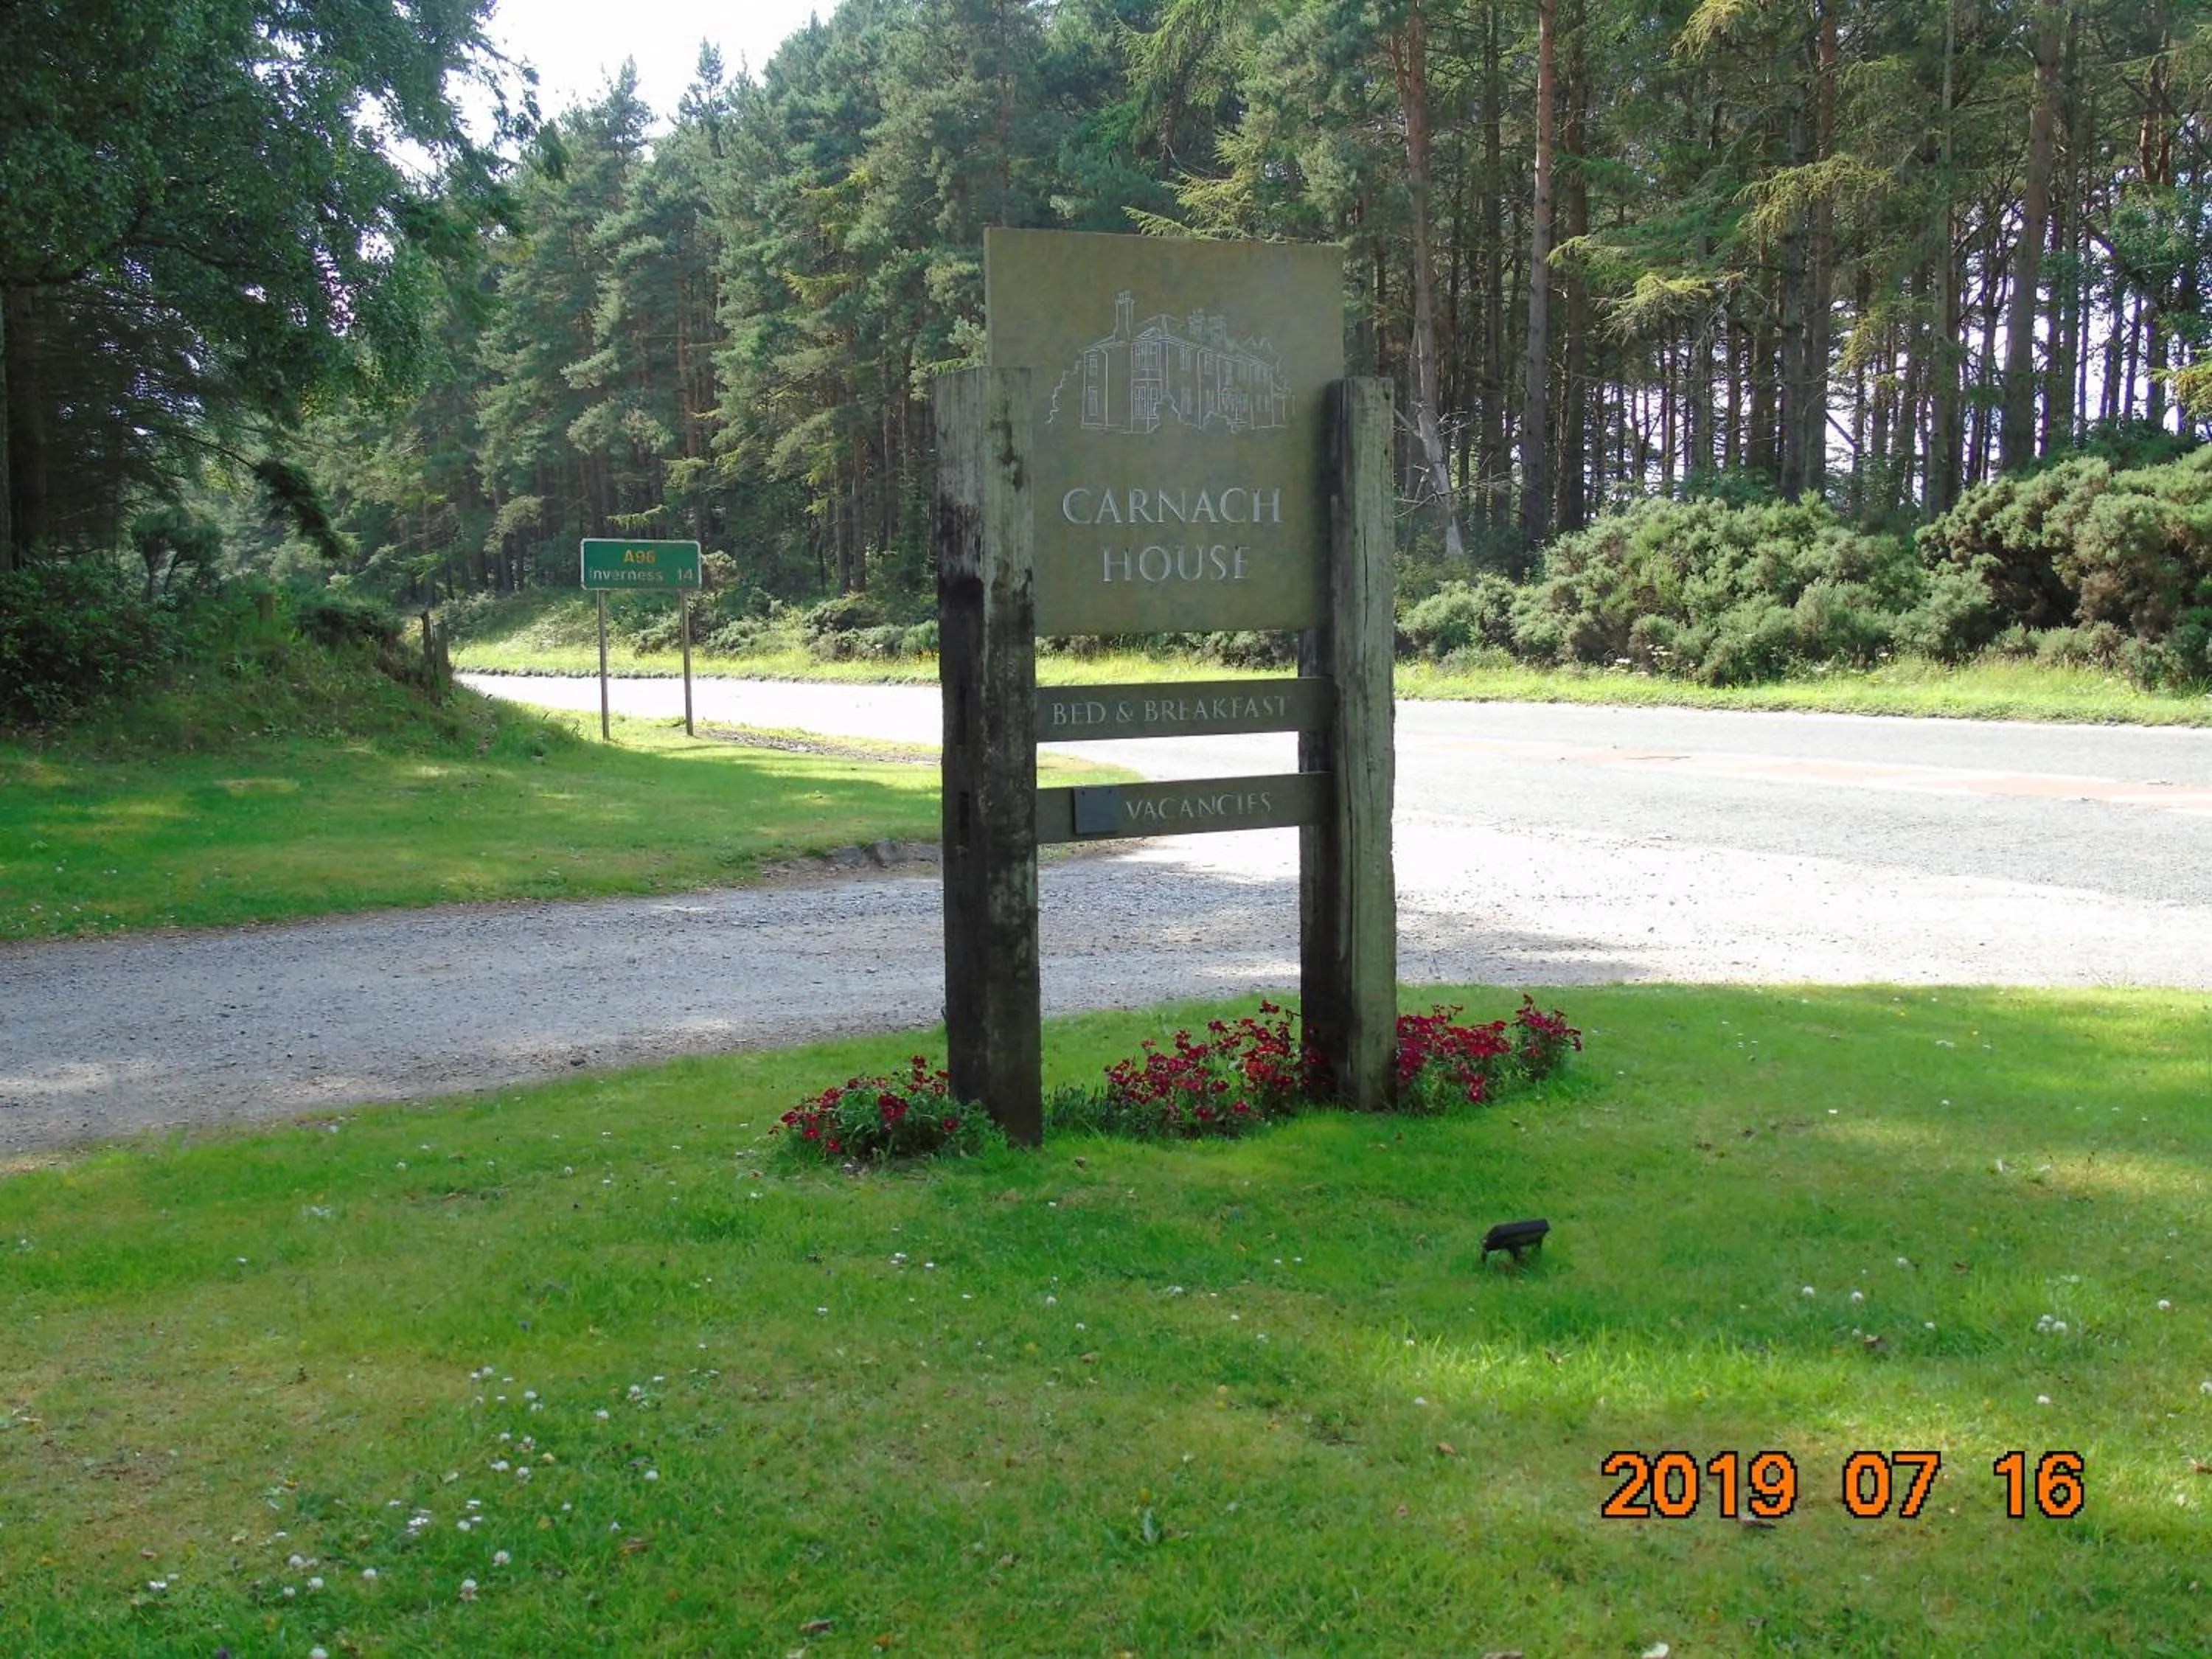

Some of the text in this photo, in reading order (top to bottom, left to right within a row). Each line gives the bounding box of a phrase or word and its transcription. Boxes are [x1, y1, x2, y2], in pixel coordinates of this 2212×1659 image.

[1062, 487, 1283, 525] CARNACH
[624, 549, 655, 563] A96
[1102, 545, 1251, 582] HOUSE
[676, 568, 693, 581] 14
[1051, 695, 1290, 726] BED & BREAKFAST
[1125, 792, 1273, 821] VACANCIES
